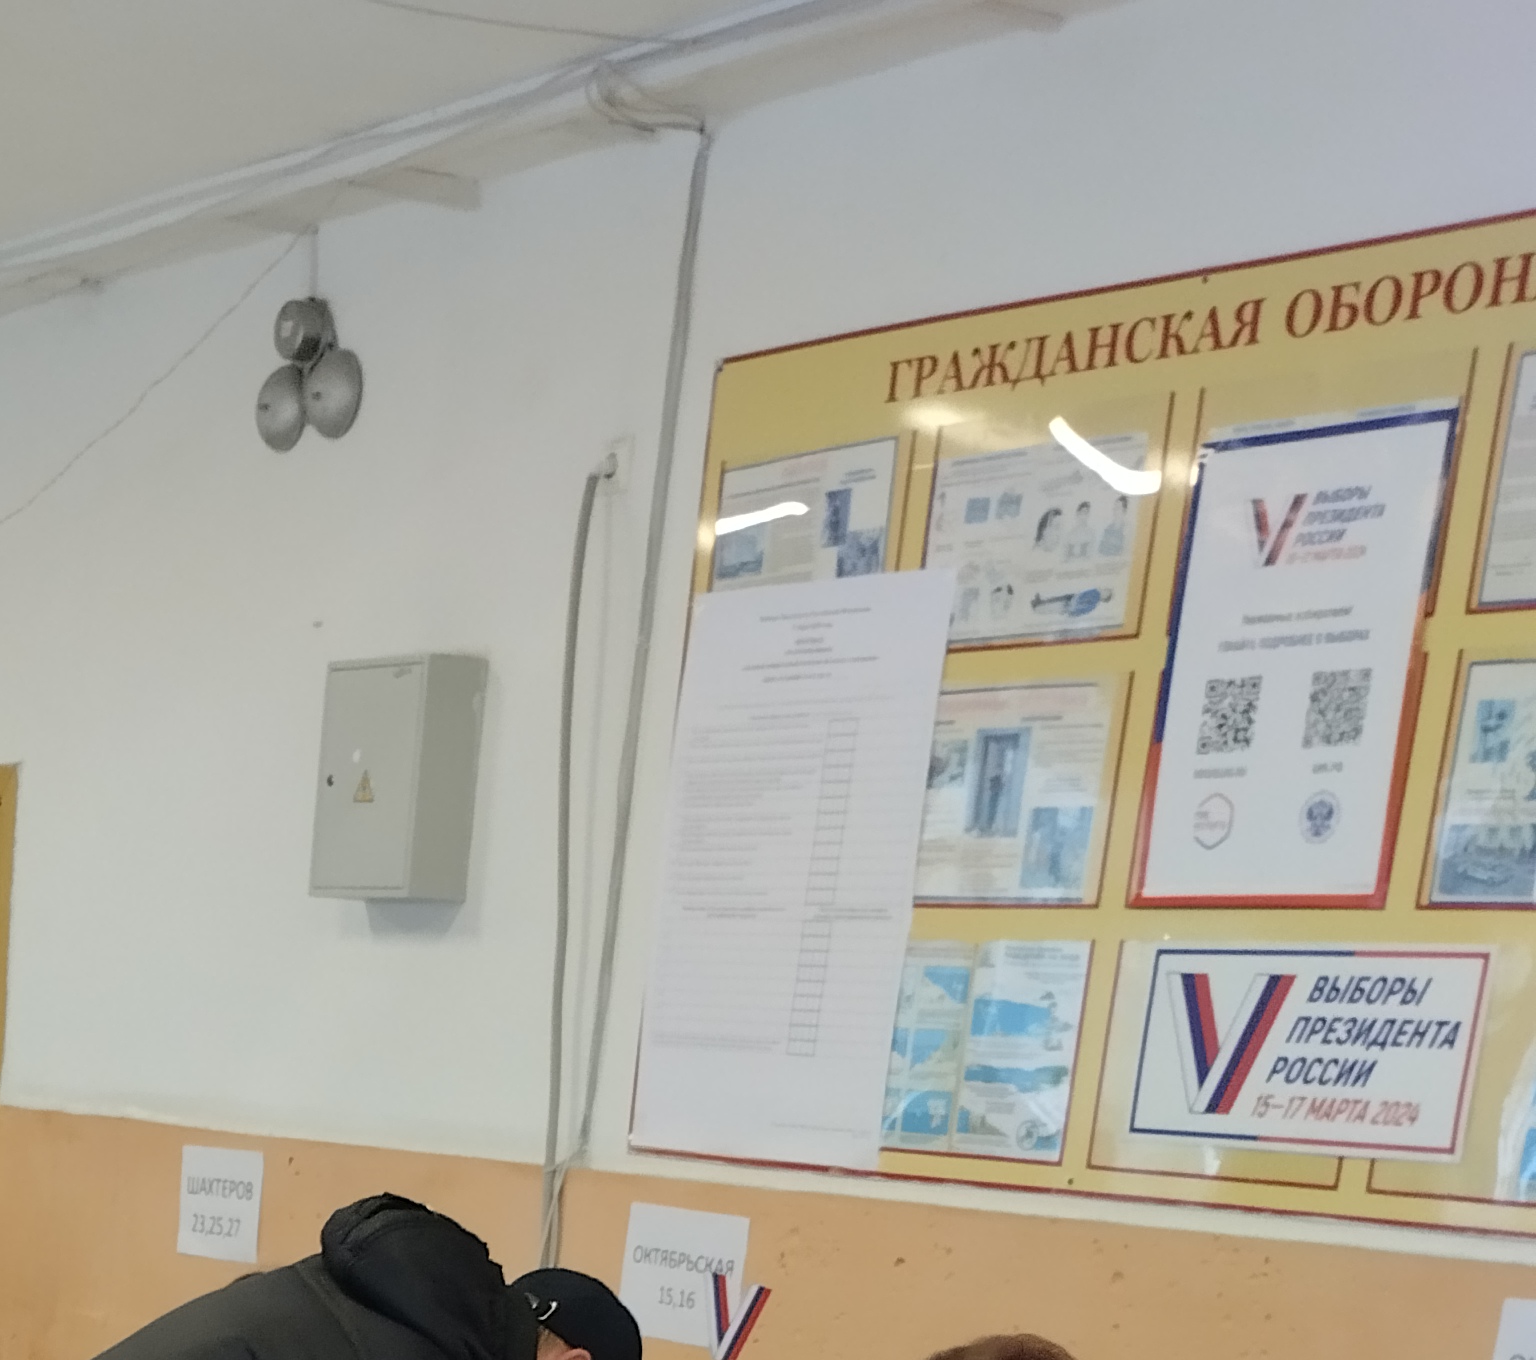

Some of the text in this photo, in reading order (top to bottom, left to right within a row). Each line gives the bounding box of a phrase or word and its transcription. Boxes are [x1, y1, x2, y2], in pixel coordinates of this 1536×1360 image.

[885, 252, 1536, 403] ГРАЖДАНСКАЯ ОБОРОН
[1306, 975, 1432, 1006] ВЫБОРЫ
[1285, 1016, 1462, 1051] ПРЕЗИДЕНТА
[1266, 1056, 1378, 1087] РОССИИ
[1303, 1097, 1370, 1124] МАРТА
[1369, 1101, 1421, 1126] 2024
[187, 1176, 254, 1201] ШАХТЕРОВ
[632, 1245, 735, 1277] ОКТЯБРЬСКАЯ
[658, 1285, 696, 1309] 15,16
